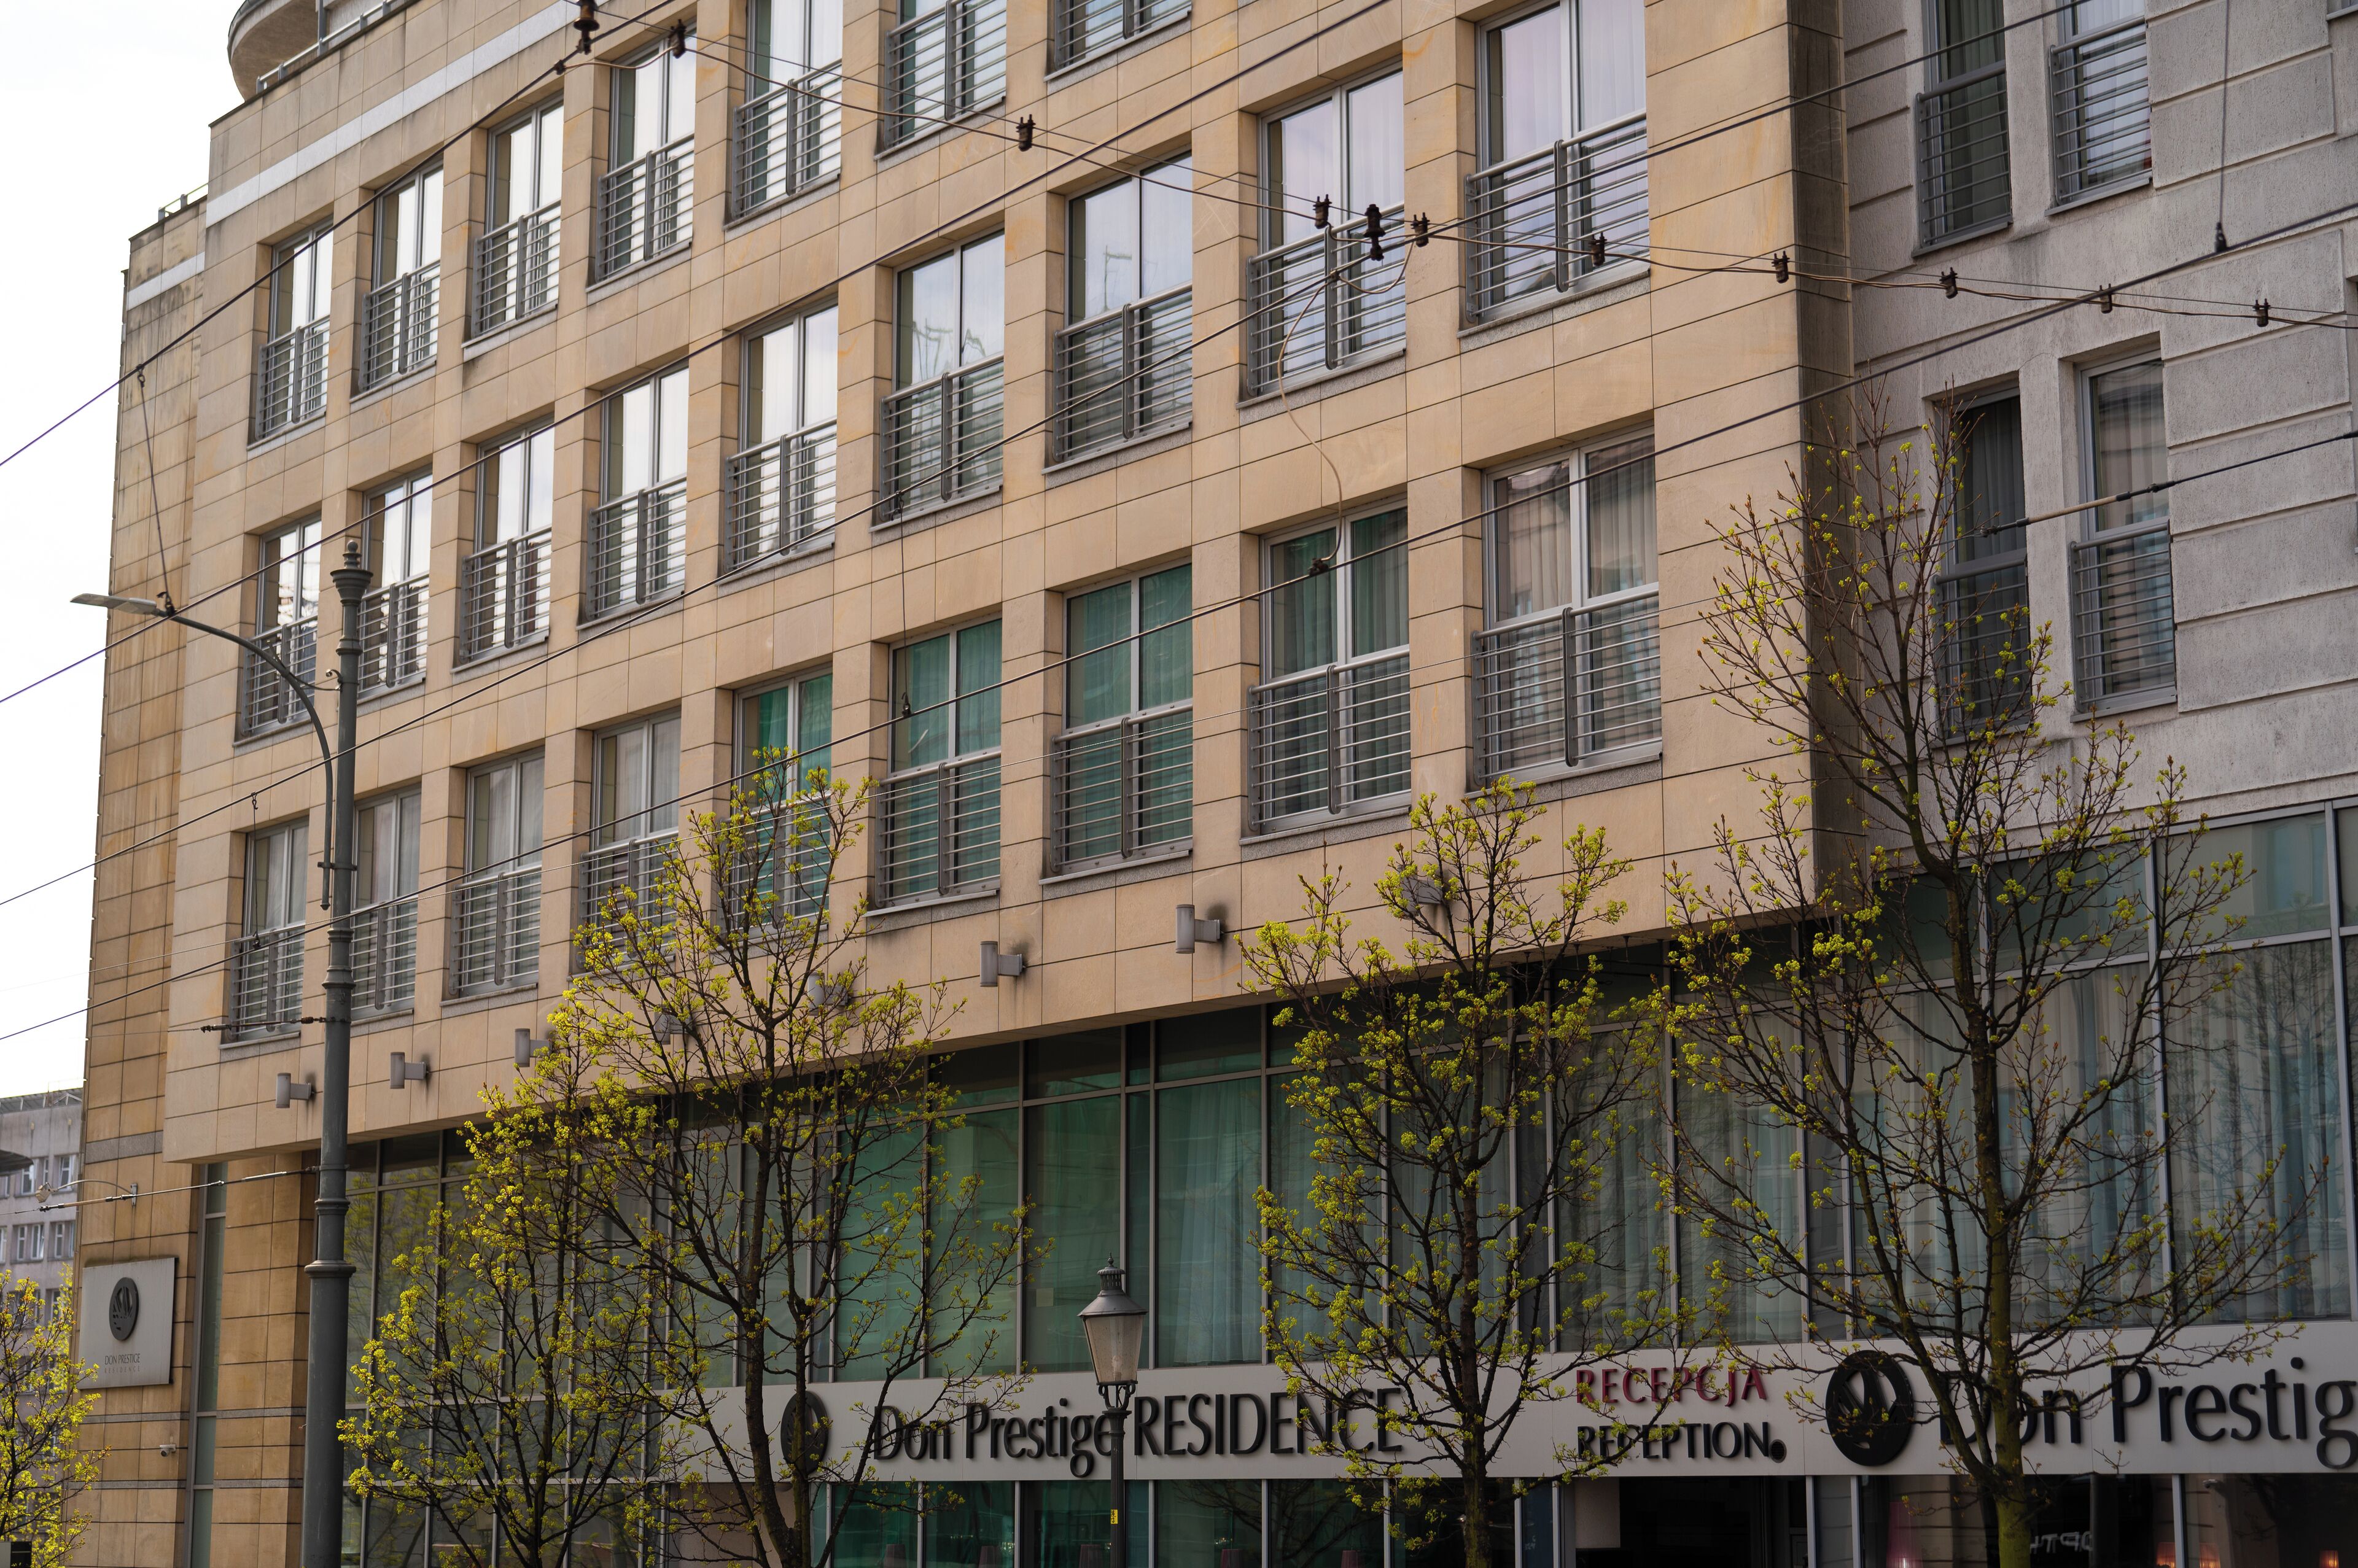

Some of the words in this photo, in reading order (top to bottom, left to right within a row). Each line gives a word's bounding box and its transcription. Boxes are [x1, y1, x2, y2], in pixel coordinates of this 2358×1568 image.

[104, 1355, 117, 1365] DON
[118, 1353, 141, 1364] PRESTIGE
[1576, 1364, 1767, 1407] RECEPCJA
[874, 1405, 951, 1460] Don
[965, 1397, 1113, 1478] Prestige
[1134, 1388, 1403, 1455] RESIDENCE
[2110, 1356, 2358, 1470] Prestig
[1576, 1421, 1769, 1460] RECEPTION
